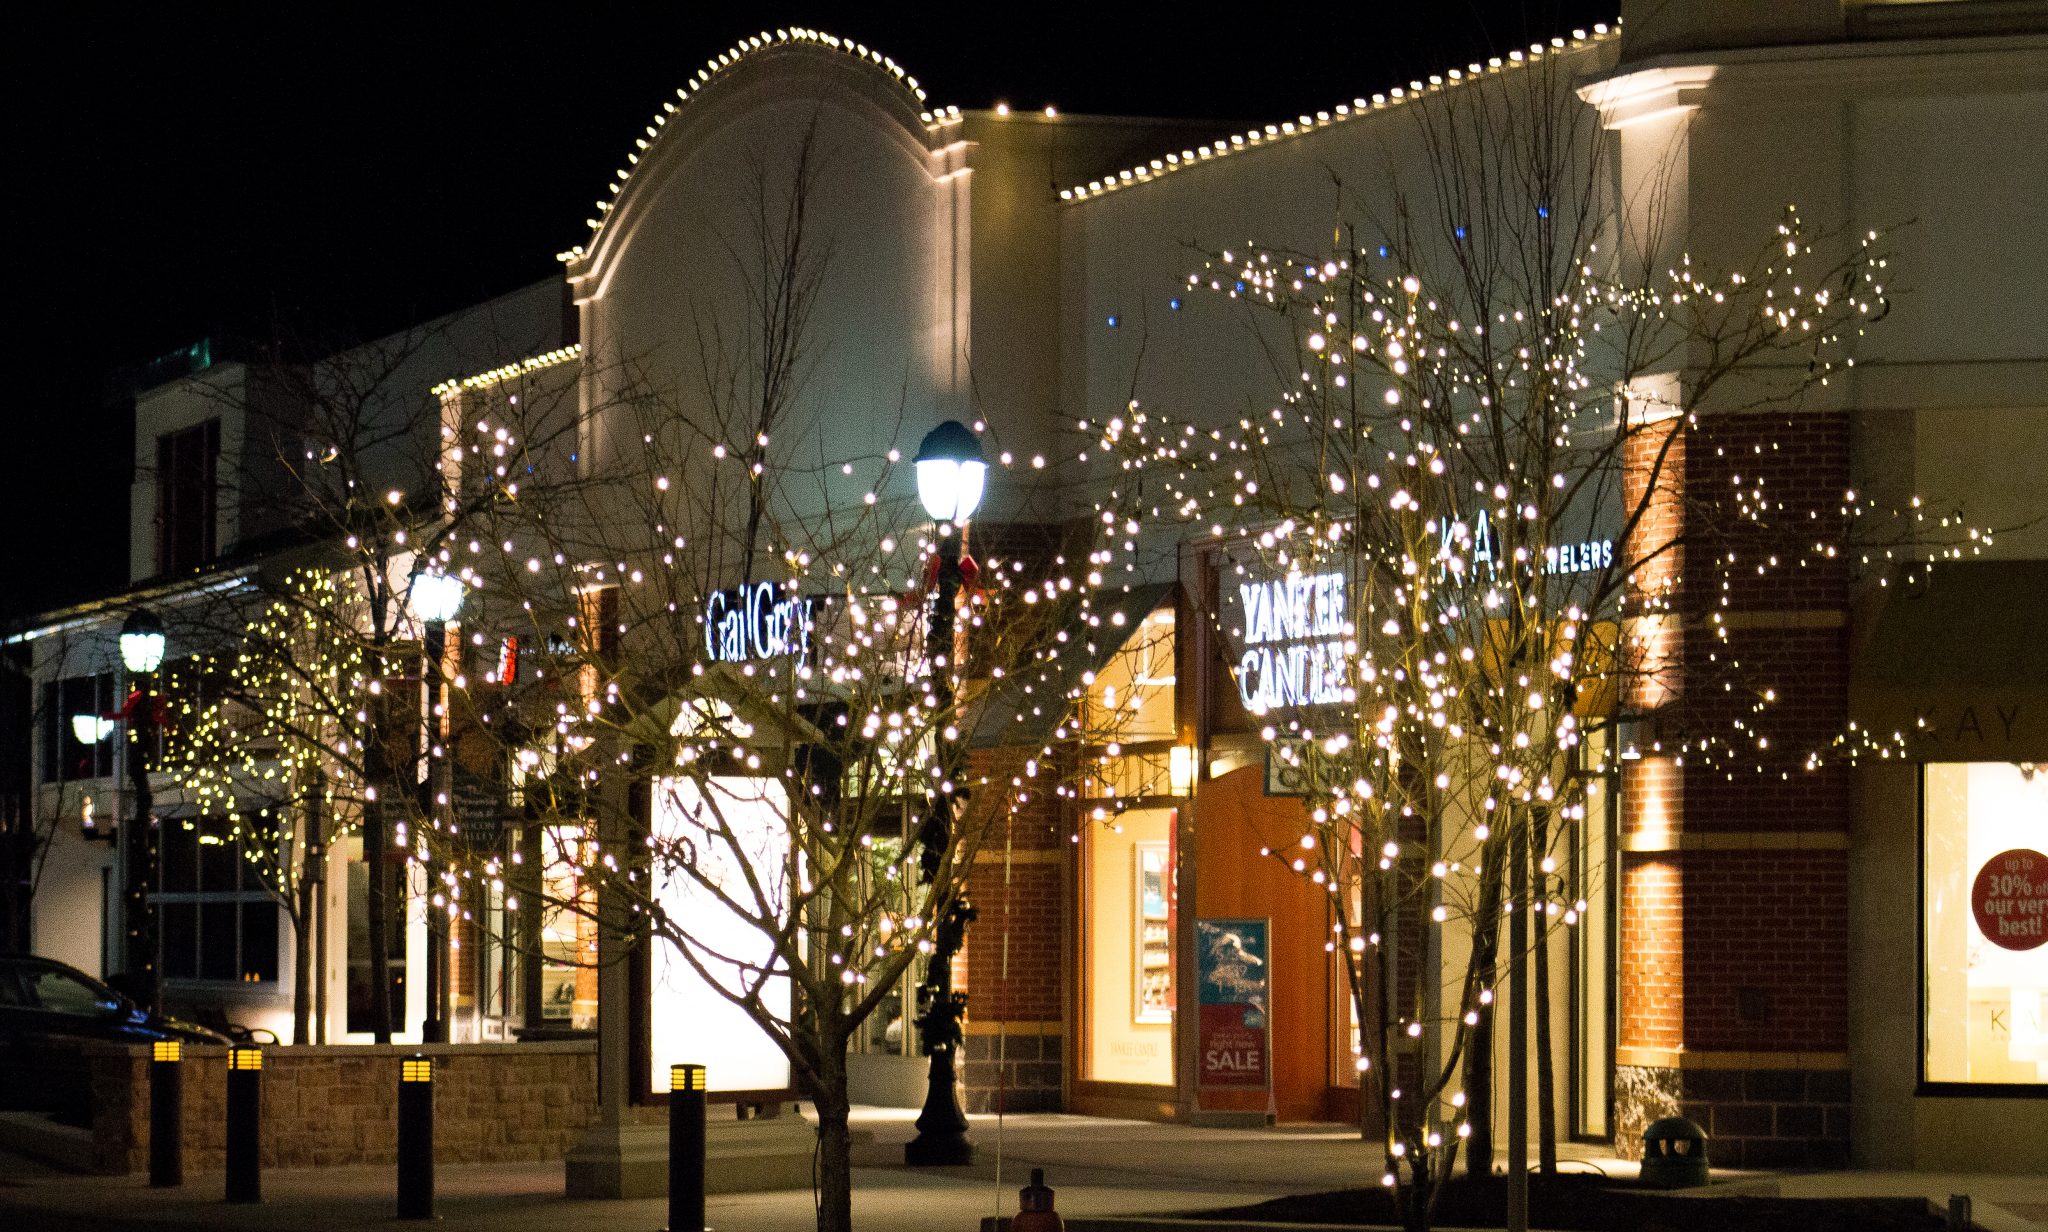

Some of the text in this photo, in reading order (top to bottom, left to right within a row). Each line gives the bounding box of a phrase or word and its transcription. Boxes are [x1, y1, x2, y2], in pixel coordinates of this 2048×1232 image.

[1239, 573, 1344, 643] YANKEE
[1239, 641, 1344, 711] CANDLE
[1911, 705, 2019, 742] KAY
[2005, 856, 2034, 873] up to
[1989, 874, 2033, 897] 30%
[1984, 899, 2014, 915] our
[2000, 916, 2042, 936] best!
[1206, 1049, 1260, 1071] SALE
